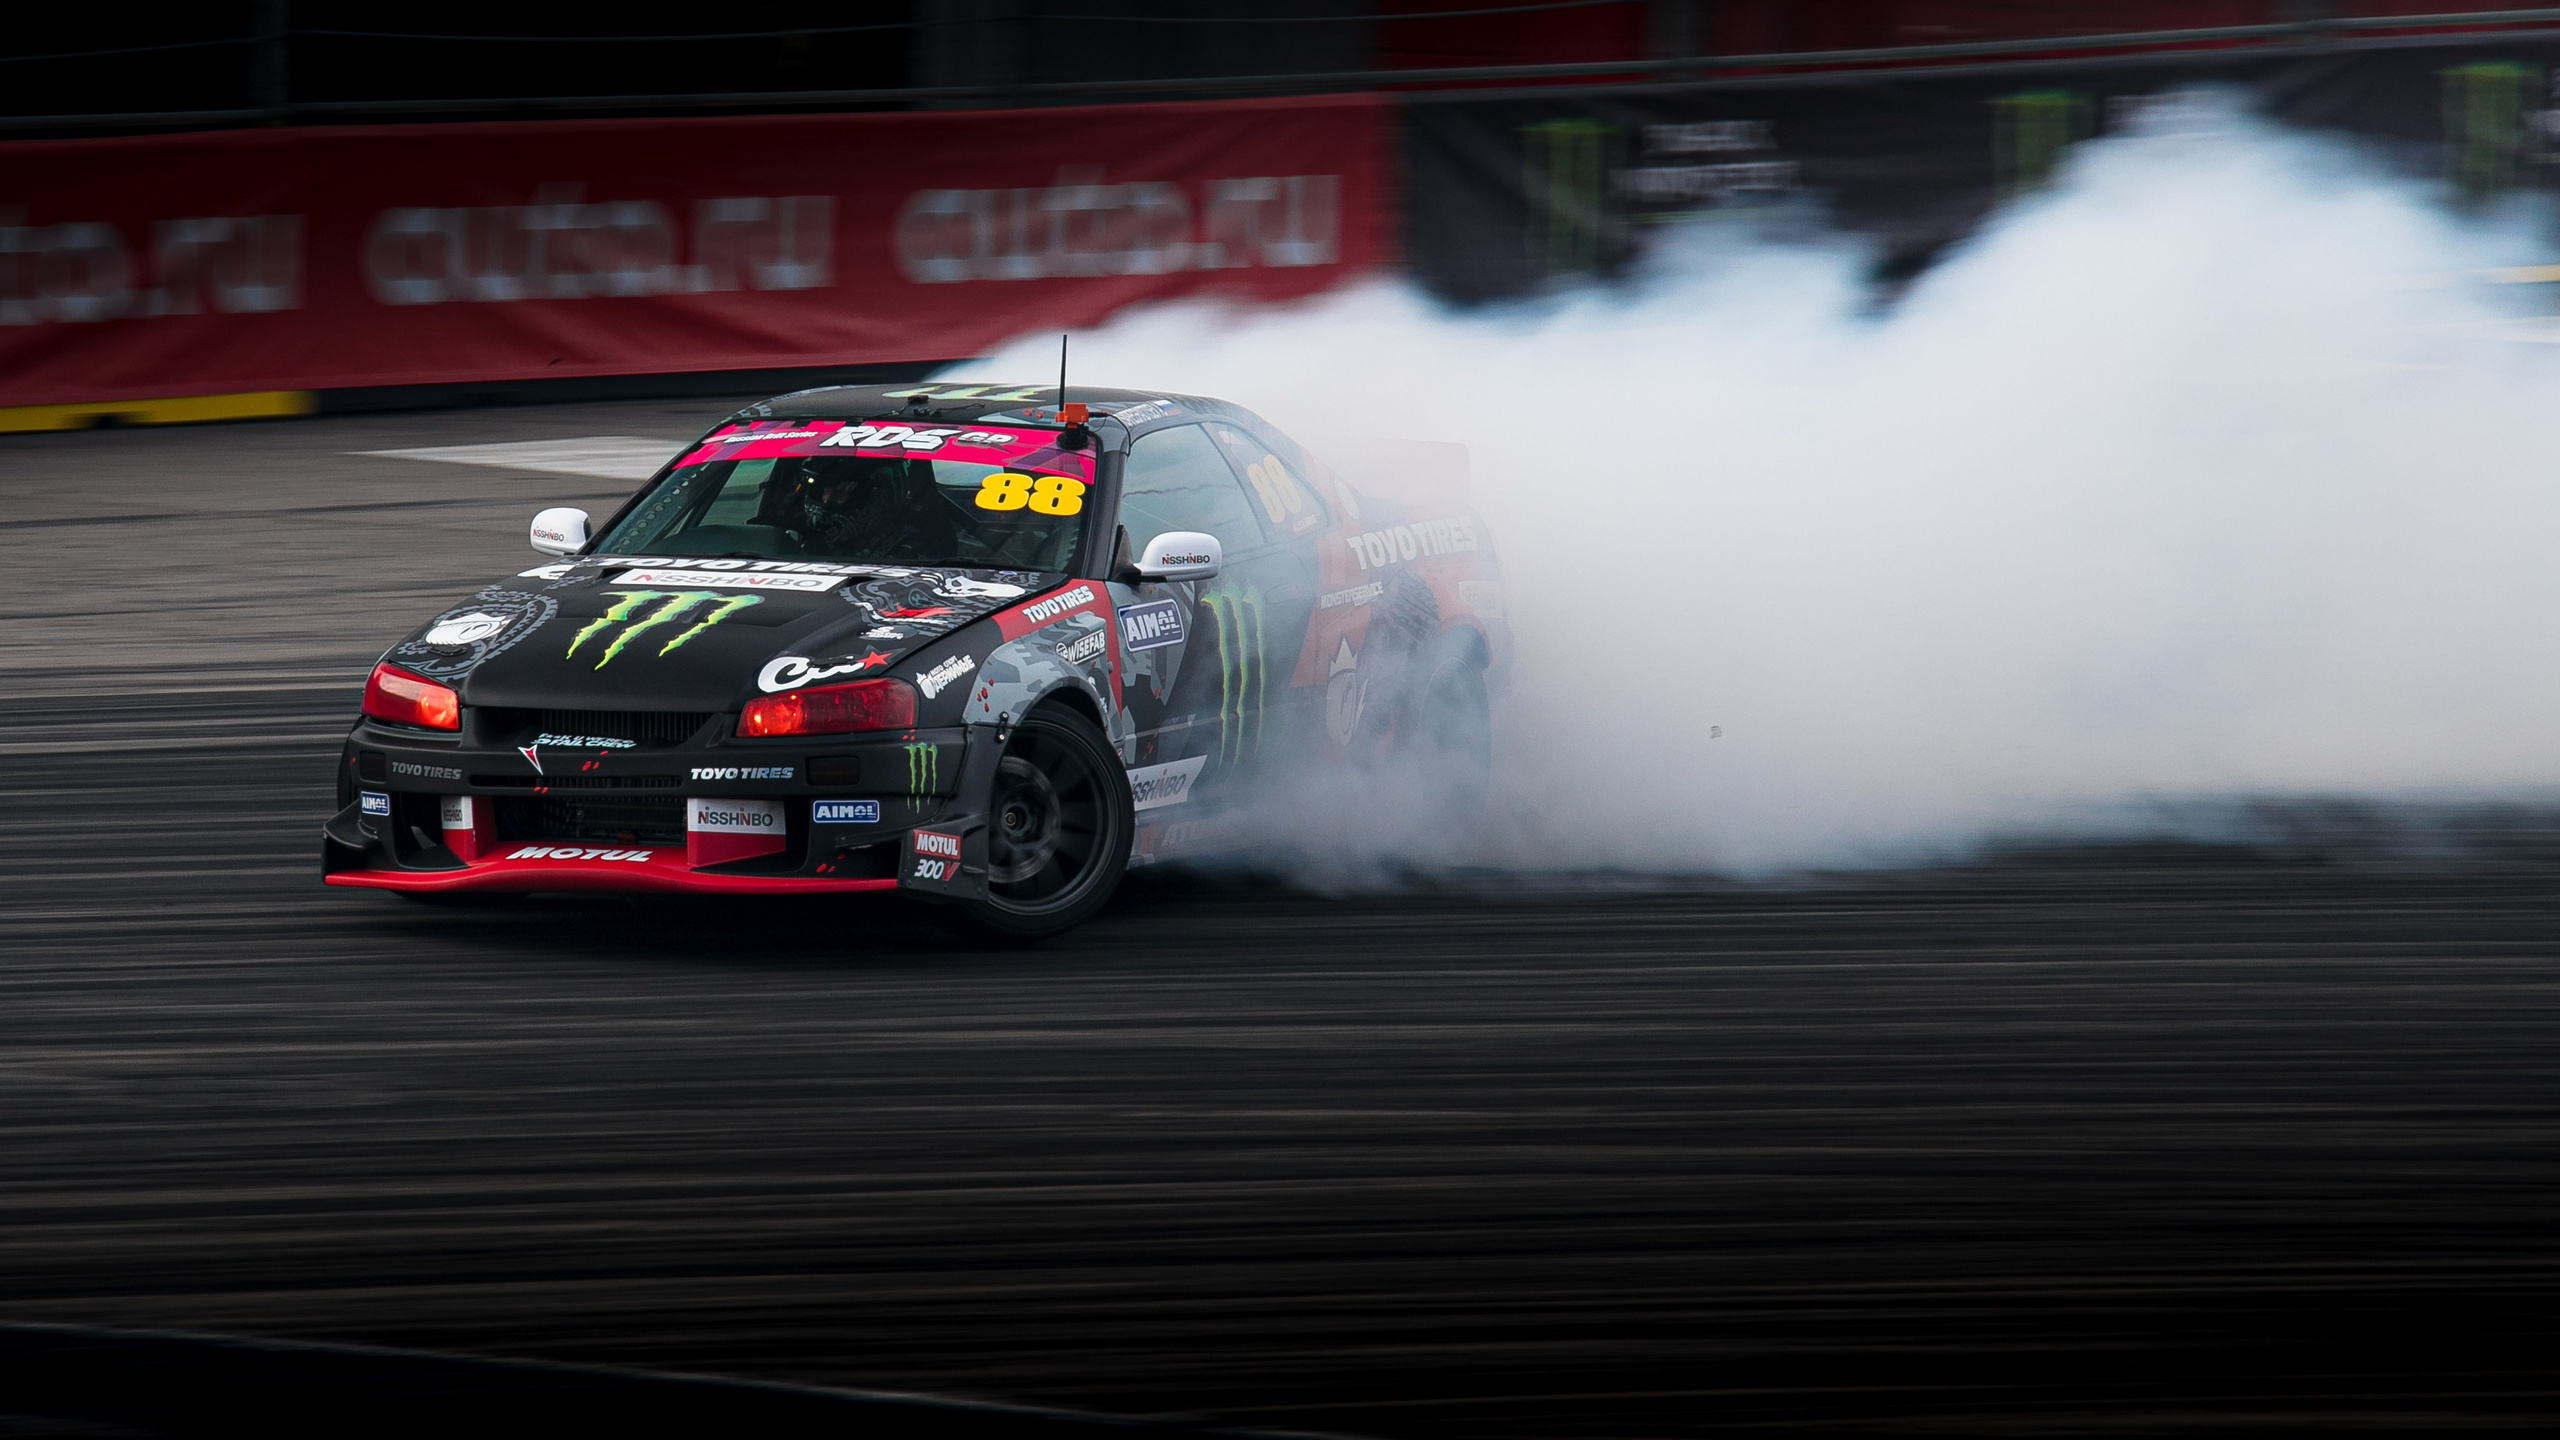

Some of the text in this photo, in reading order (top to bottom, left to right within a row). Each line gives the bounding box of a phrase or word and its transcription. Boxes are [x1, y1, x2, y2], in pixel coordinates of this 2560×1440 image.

[893, 164, 1342, 283] auto.ru
[362, 182, 833, 304] auto.ru
[724, 434, 764, 443] Russian
[785, 431, 818, 439] Series
[819, 426, 1013, 451] RDS GP
[975, 472, 1085, 516] 88
[1248, 454, 1302, 523] 88
[1347, 516, 1477, 570] TOYO TIRES
[597, 557, 914, 577] TOYO TIRES
[1022, 585, 1094, 624] TOYO TIRES
[1068, 631, 1106, 662] WISEFAB
[392, 761, 462, 780] TOYO TIRES
[691, 767, 794, 780] TOYO TIRES
[697, 806, 774, 827] NISSHINBO
[816, 805, 876, 818] AIMOL
[505, 846, 653, 862] MOTUL
[916, 833, 959, 856] MOTUL
[914, 859, 960, 881] 300V
